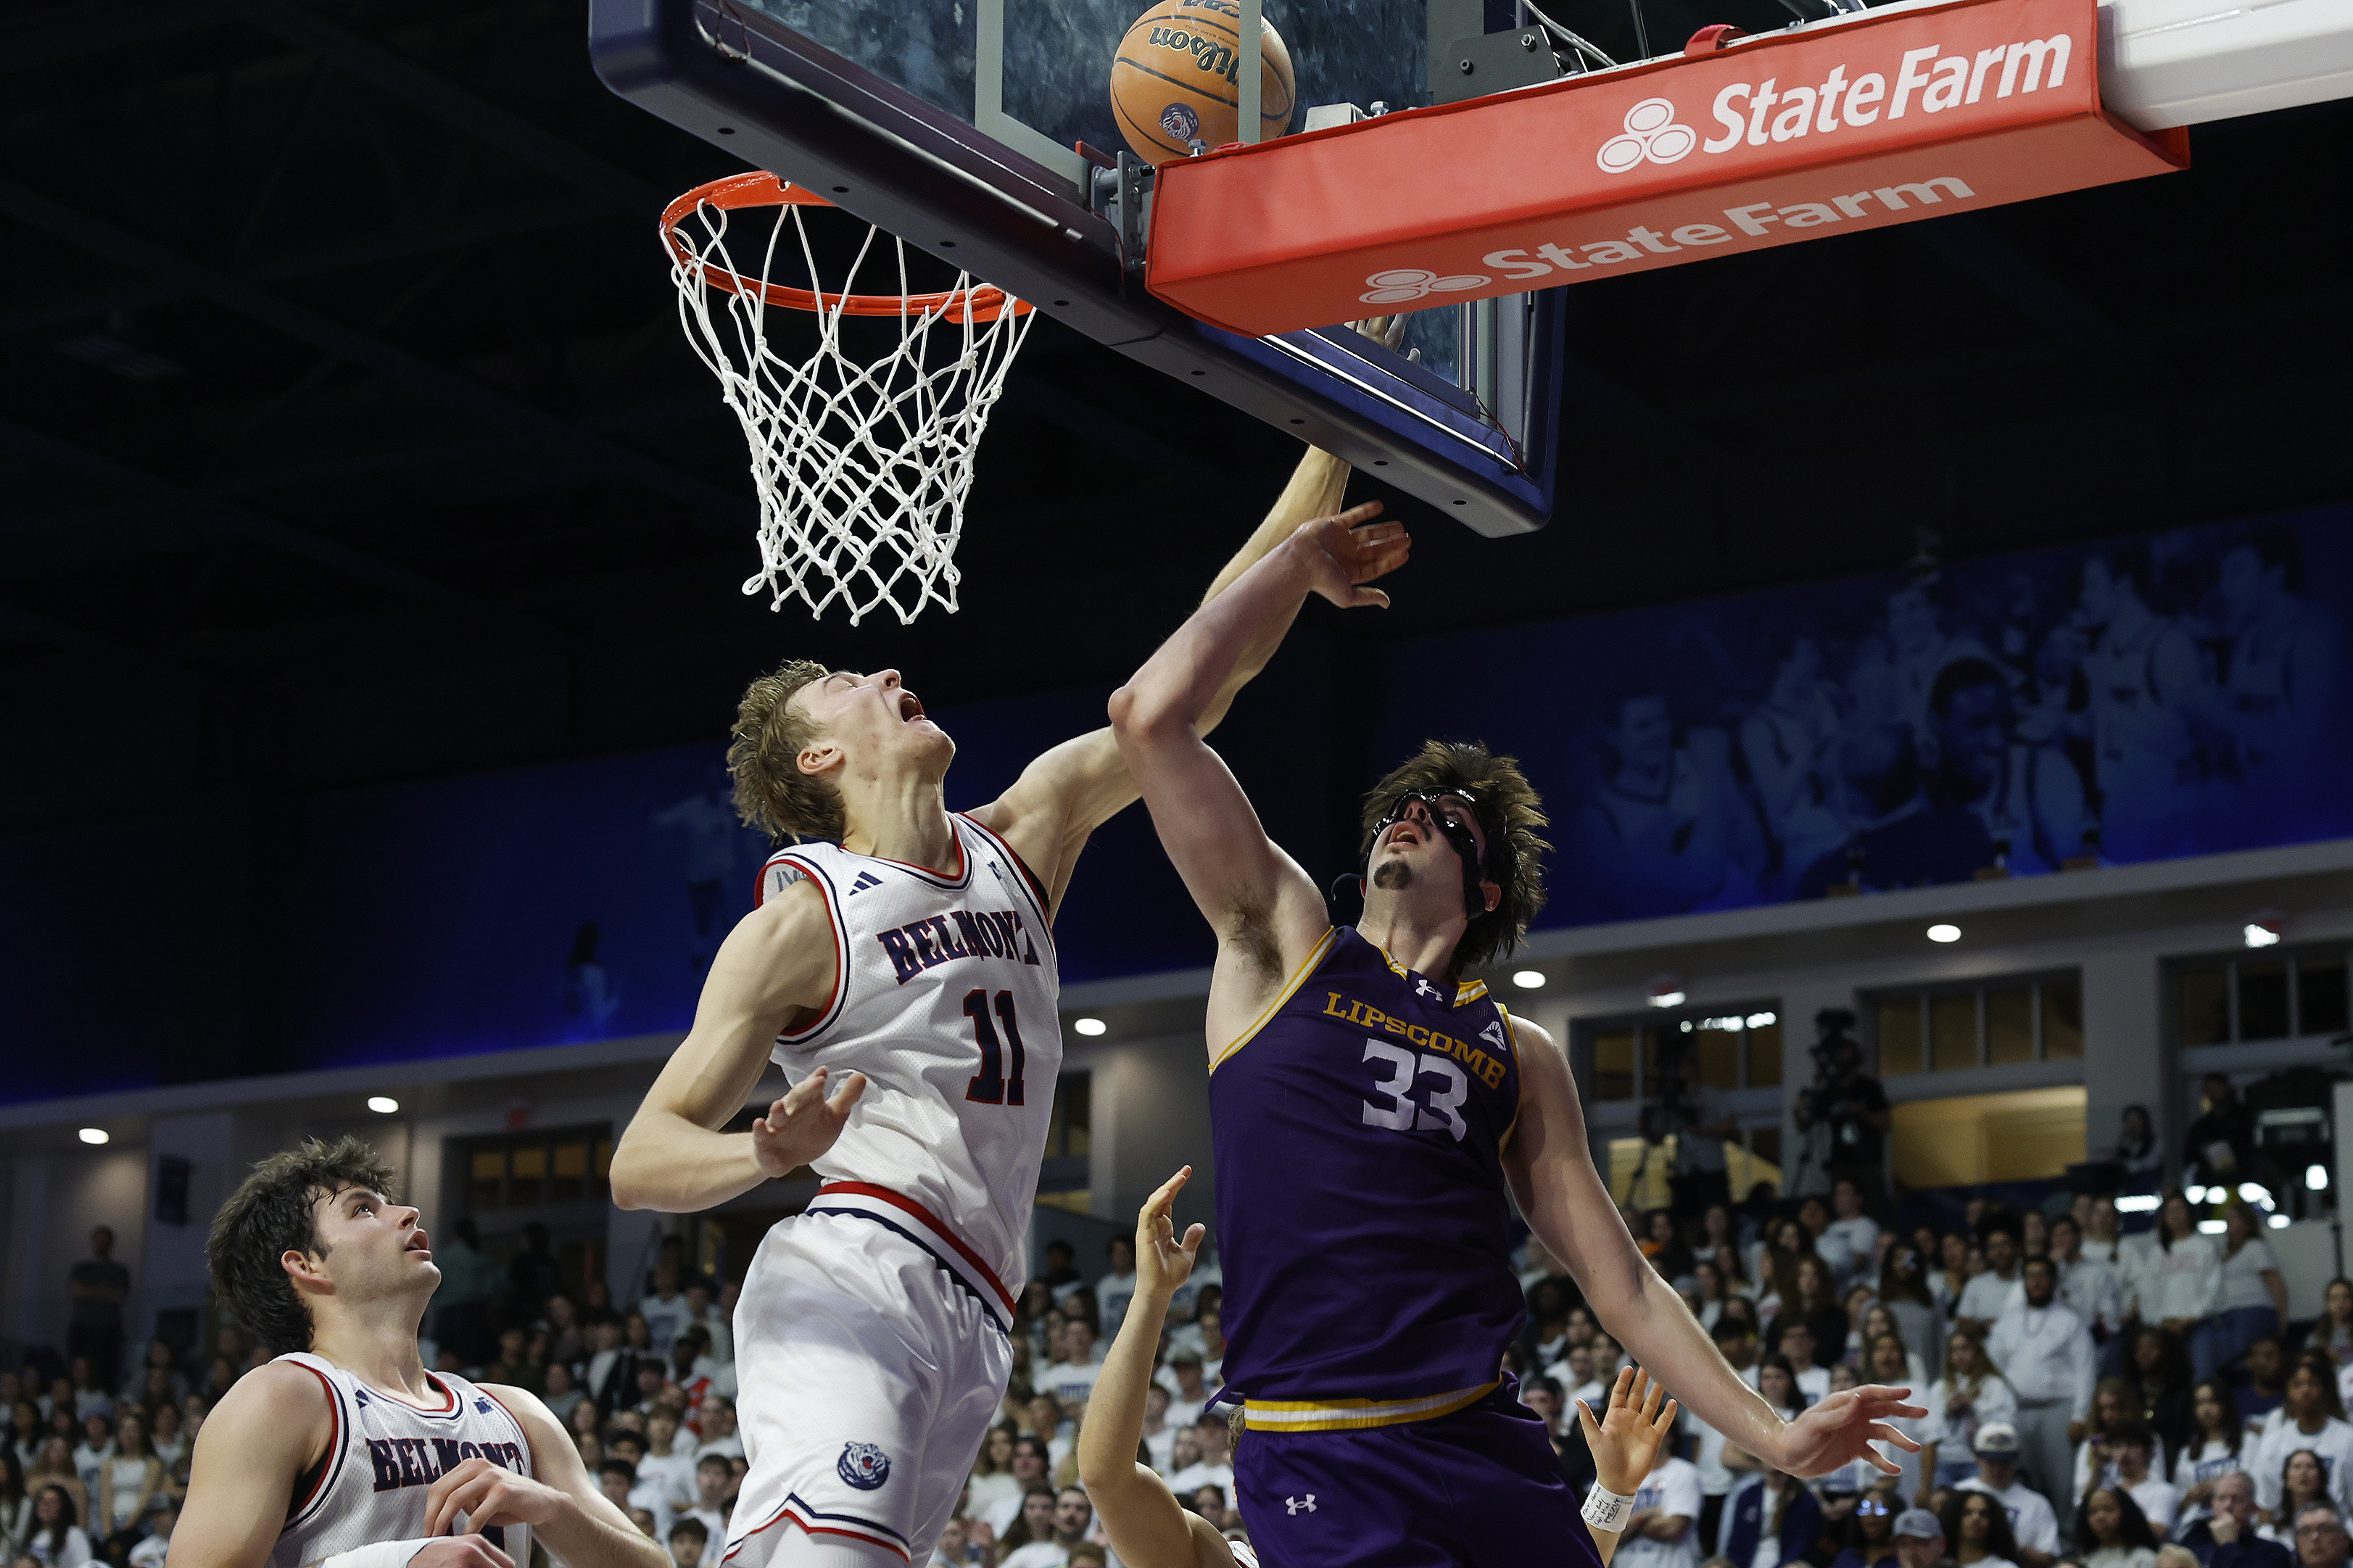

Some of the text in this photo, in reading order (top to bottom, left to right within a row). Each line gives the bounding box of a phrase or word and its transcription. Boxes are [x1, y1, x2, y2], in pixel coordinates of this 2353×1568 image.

[877, 910, 1041, 985] BELMONT
[963, 989, 1025, 1107] 11
[1323, 991, 1507, 1090] LIPSCOMB
[1362, 1038, 1468, 1142] 33
